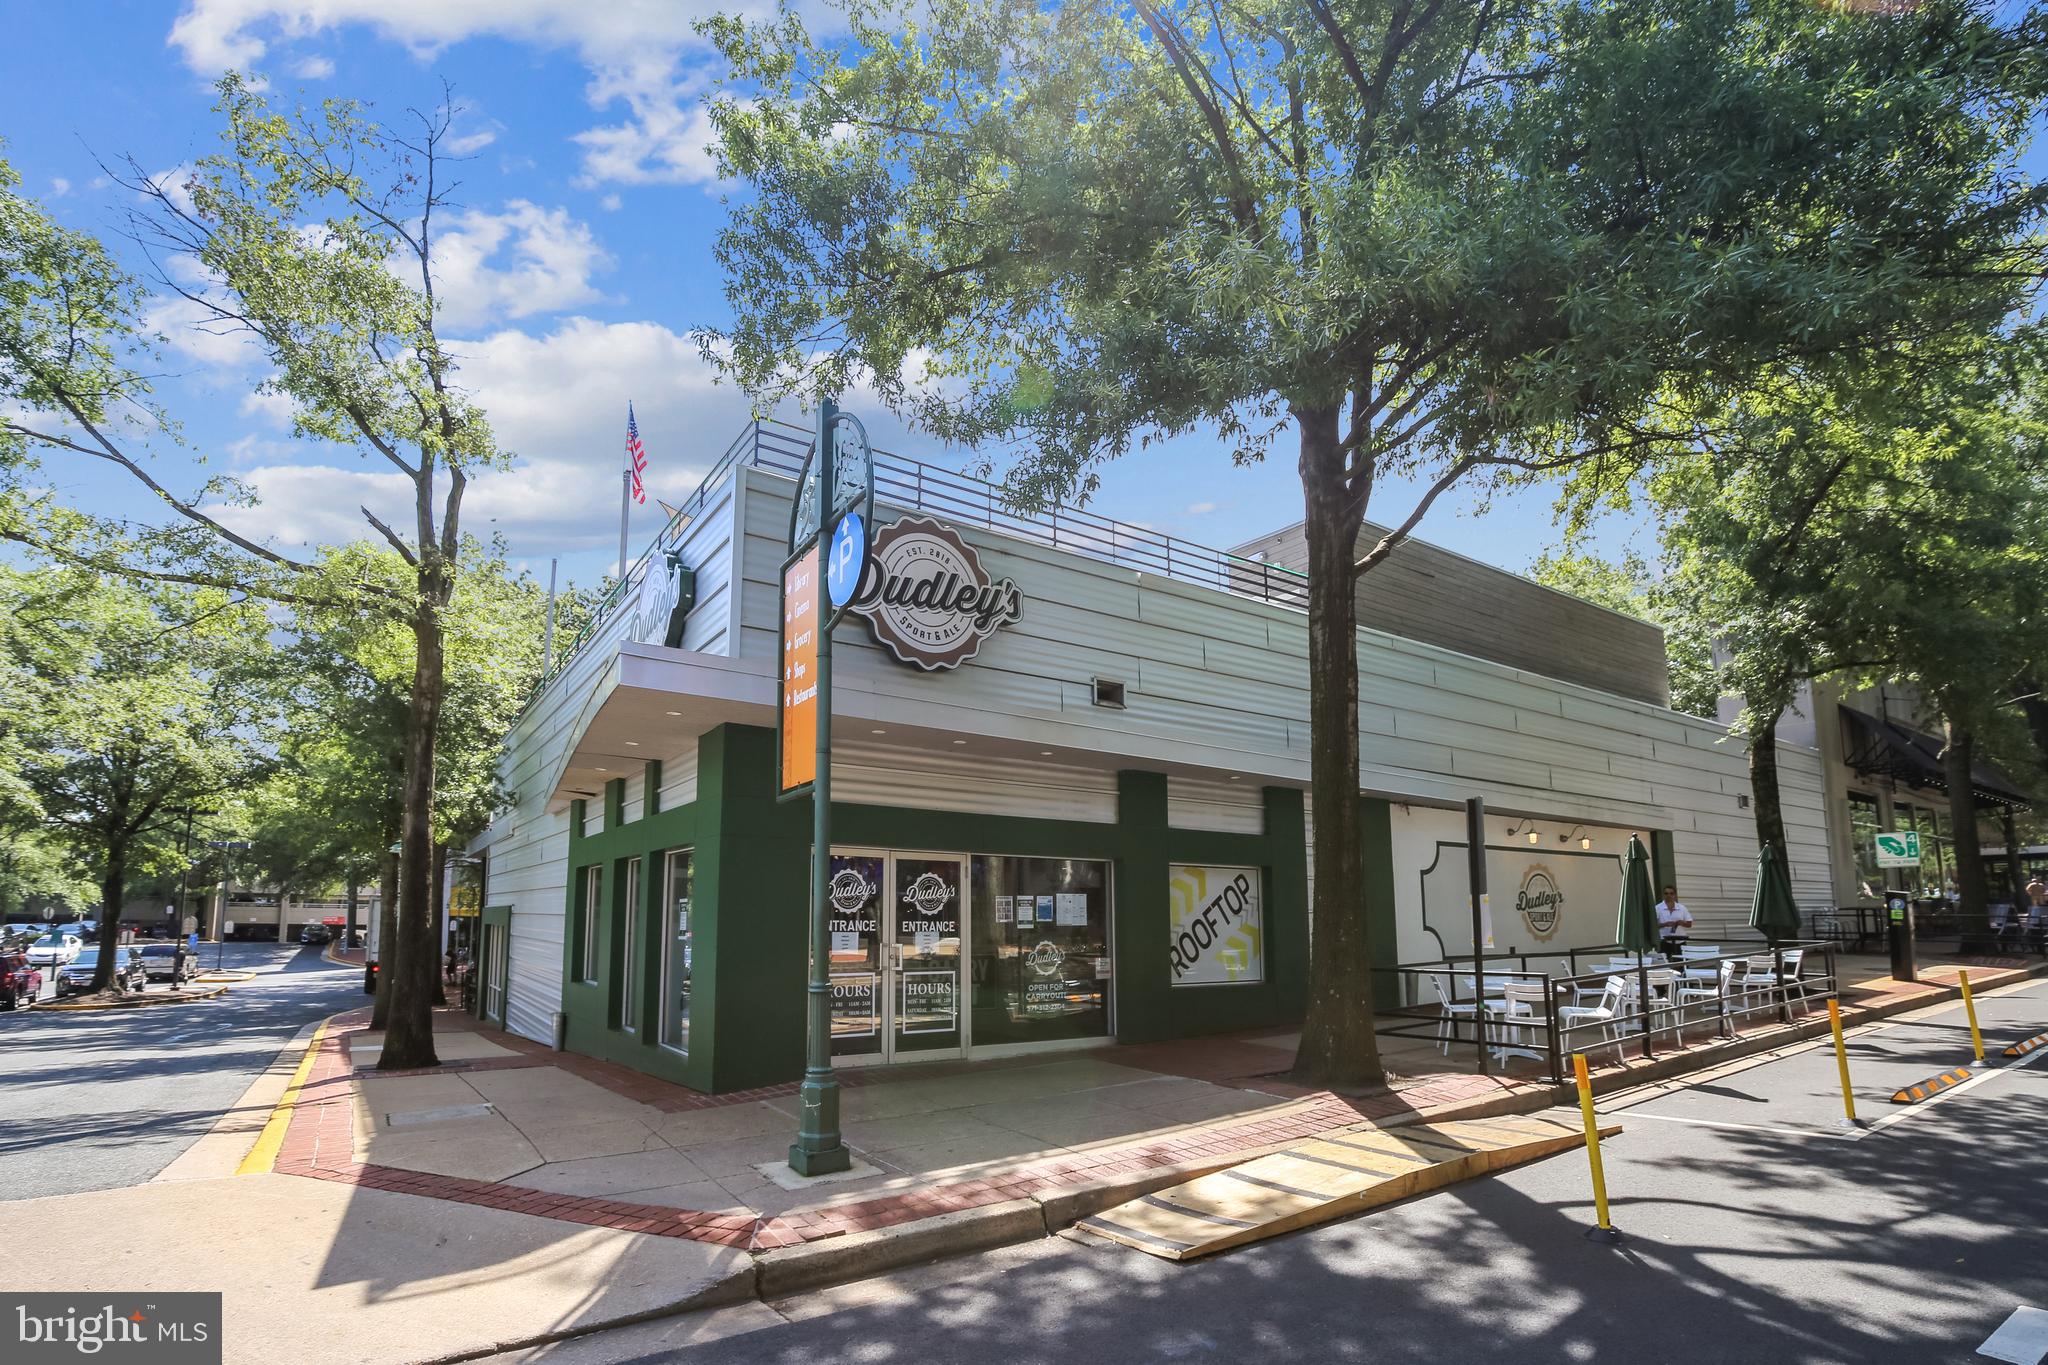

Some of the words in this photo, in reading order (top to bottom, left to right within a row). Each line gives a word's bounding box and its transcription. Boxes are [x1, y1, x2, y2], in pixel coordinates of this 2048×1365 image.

[839, 535, 854, 584] P
[906, 547, 926, 558] EST.
[858, 556, 1020, 630] Dudley's
[900, 616, 932, 640] SPORT
[935, 631, 942, 641] &
[944, 623, 960, 638] ALE
[794, 627, 811, 651] Grocery
[794, 661, 806, 679] Shops
[829, 882, 877, 900] Dudley's
[903, 885, 956, 903] Dudley's
[1516, 890, 1564, 911] Dudley's
[829, 920, 877, 932] TRANCE
[902, 921, 956, 932] ENTRANCE
[1170, 873, 1250, 978] ROOFTOP
[831, 984, 871, 997] OURS
[907, 982, 951, 995] HOURS
[1028, 983, 1049, 992] OPEN
[1050, 983, 1064, 991] FOR
